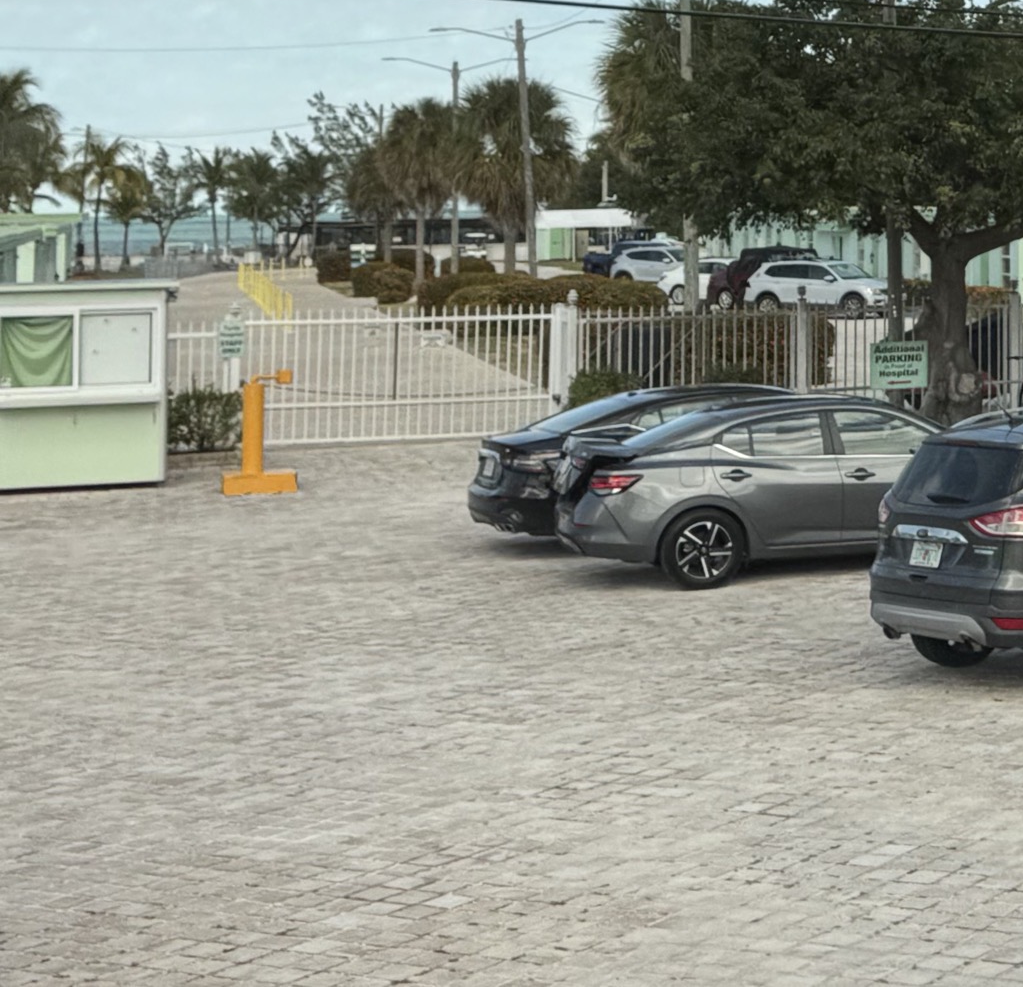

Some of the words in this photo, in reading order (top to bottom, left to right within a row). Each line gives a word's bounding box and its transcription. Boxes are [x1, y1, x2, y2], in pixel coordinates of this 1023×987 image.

[874, 344, 925, 354] Additional
[875, 354, 922, 364] PARKING
[879, 368, 919, 378] Hospital
